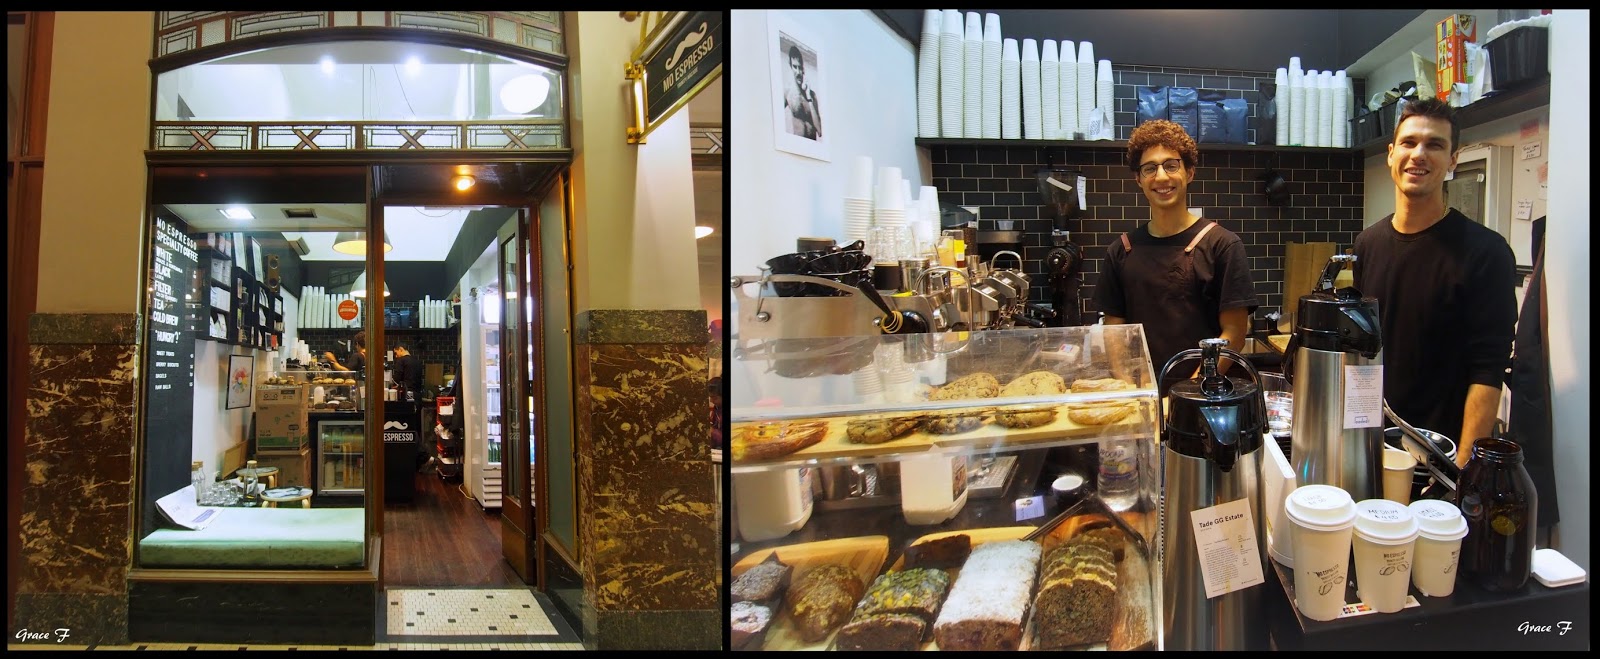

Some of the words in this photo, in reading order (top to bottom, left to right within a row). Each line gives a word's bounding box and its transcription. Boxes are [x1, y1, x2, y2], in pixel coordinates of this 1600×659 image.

[663, 73, 674, 93] MO
[674, 35, 713, 82] ESPRESSO
[156, 217, 166, 231] MO
[167, 224, 197, 251] ESPRESSO
[156, 246, 173, 264] WHITE
[183, 246, 198, 263] COFFEE
[154, 262, 171, 279] BLACK
[154, 280, 172, 296] FILTER
[153, 297, 165, 311] TEA
[153, 310, 166, 323] COLD
[166, 313, 179, 326] BREW
[384, 432, 414, 442] ESPRESSO
[1199, 520, 1214, 529] Tade
[1214, 517, 1224, 525] GG
[1225, 513, 1244, 522] Estate
